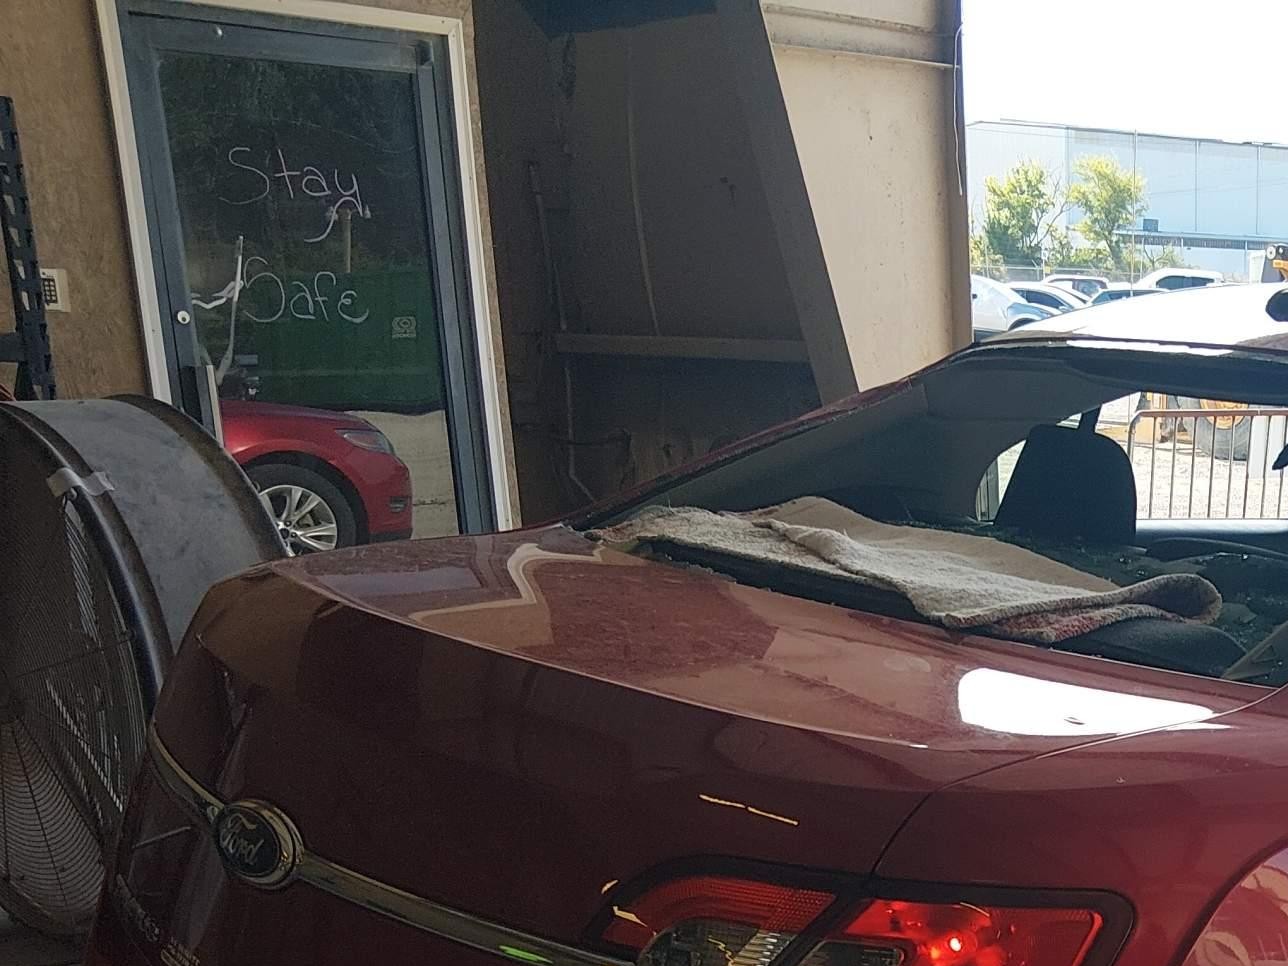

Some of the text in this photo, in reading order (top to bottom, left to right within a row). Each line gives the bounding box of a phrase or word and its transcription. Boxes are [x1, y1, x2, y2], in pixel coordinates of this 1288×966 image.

[219, 147, 364, 243] Stay
[243, 256, 369, 323] Safe
[219, 812, 266, 867] Ford
